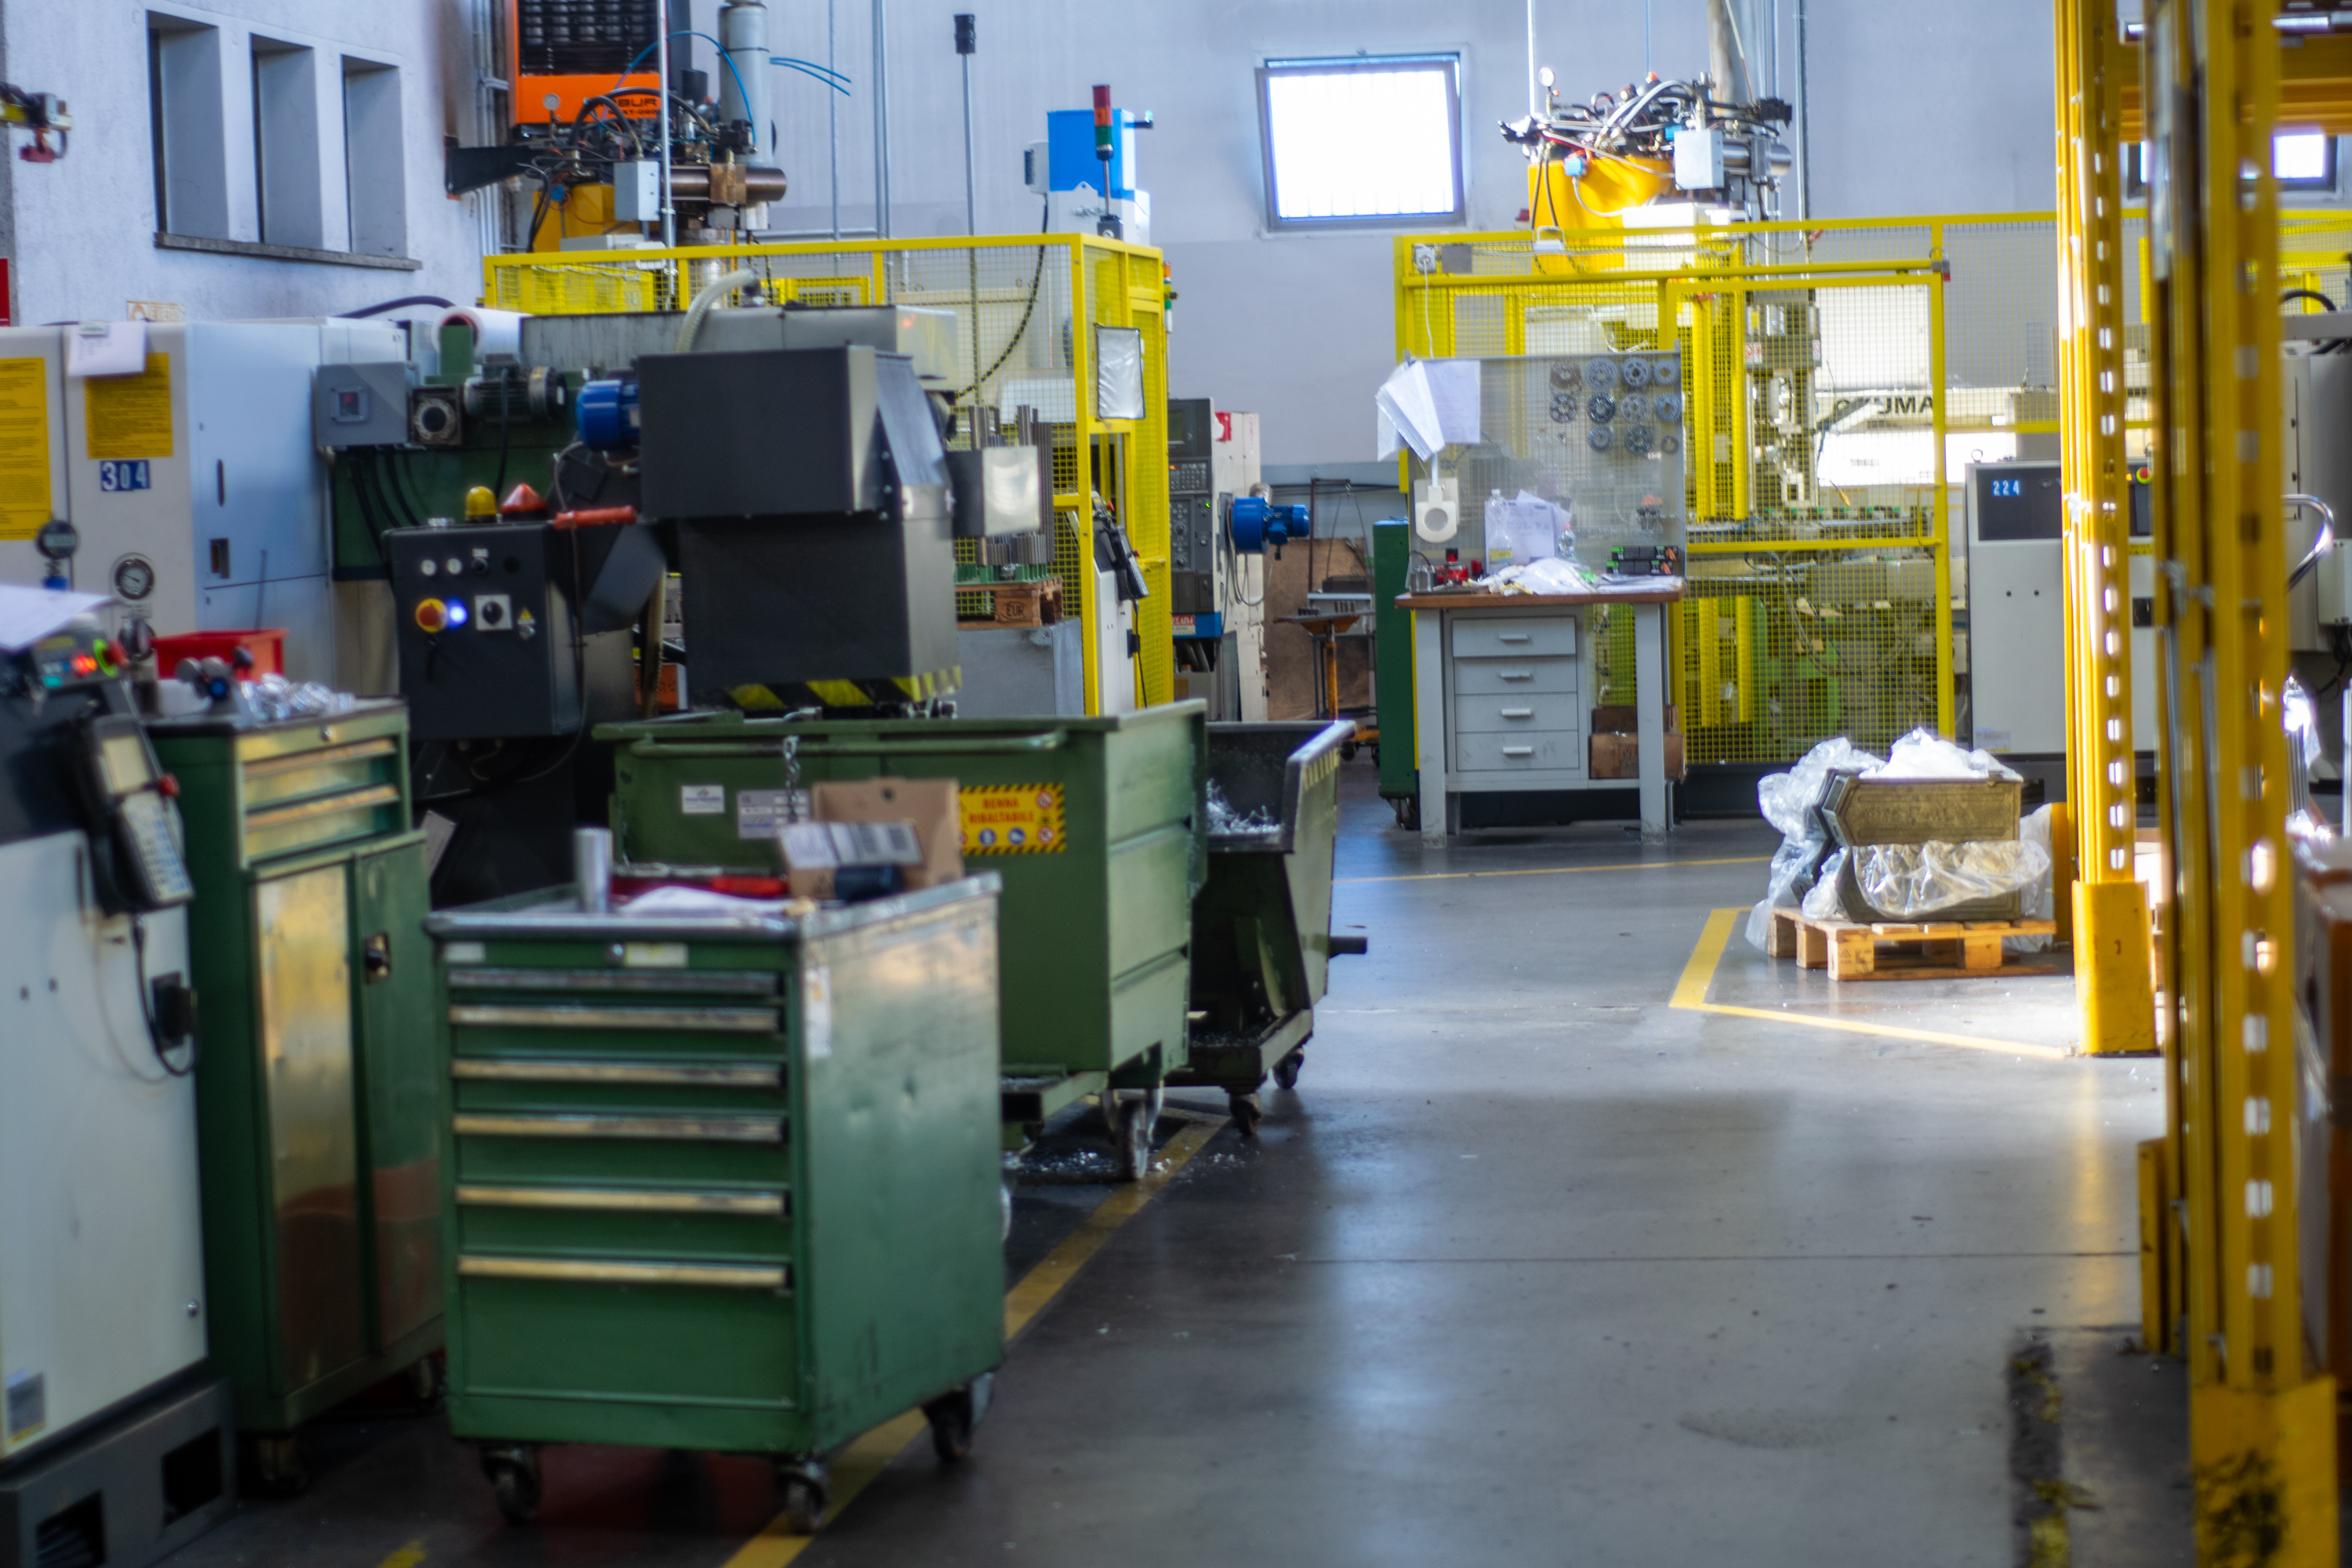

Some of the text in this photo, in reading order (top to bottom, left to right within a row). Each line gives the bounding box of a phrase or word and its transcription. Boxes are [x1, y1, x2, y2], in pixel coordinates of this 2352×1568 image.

[103, 461, 147, 490] 304
[1993, 480, 2020, 496] 224
[1007, 604, 1025, 618] EUR
[983, 798, 1018, 808] BENNA
[969, 811, 1033, 824] RIBALTABILE
